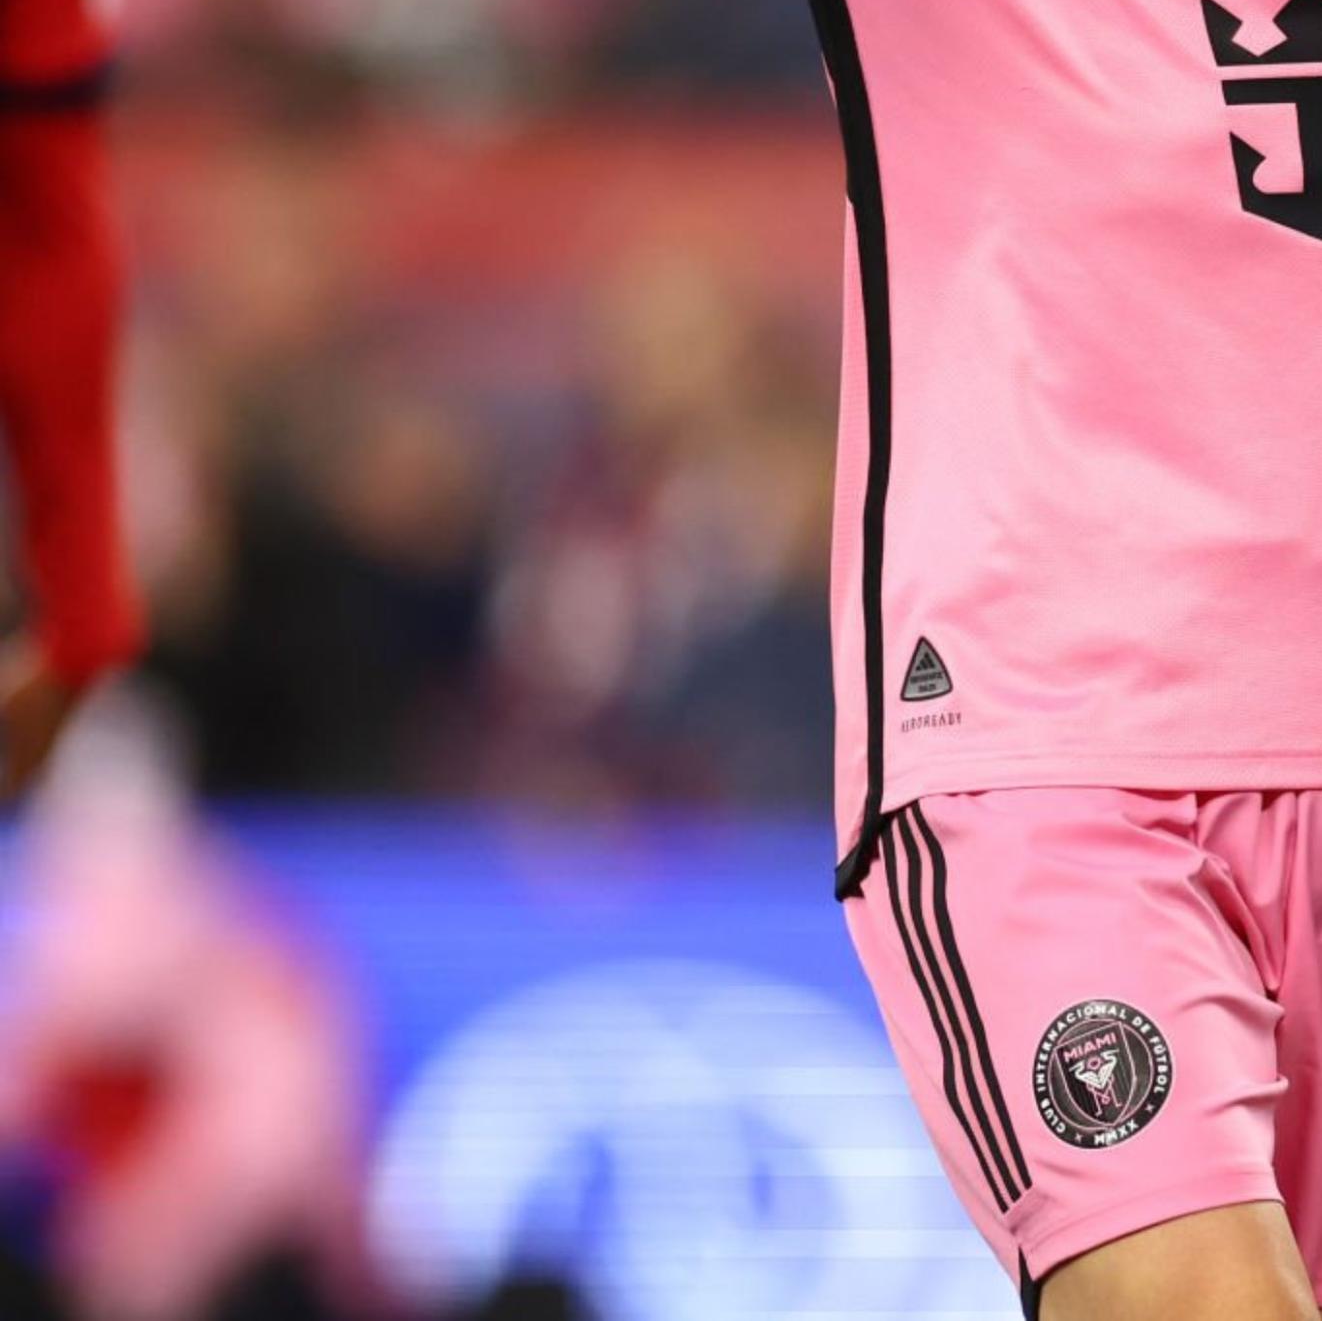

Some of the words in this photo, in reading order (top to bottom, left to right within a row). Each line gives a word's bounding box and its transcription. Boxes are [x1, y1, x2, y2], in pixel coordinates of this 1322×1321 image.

[1132, 1016, 1152, 1034] DE
[1035, 1004, 1128, 1093] INTERNACIONAL
[1063, 1031, 1117, 1064] MIAMI
[1149, 1037, 1168, 1093] FÚTBOL
[1040, 1099, 1067, 1134] CLUB
[1093, 1118, 1139, 1146] MMXX
